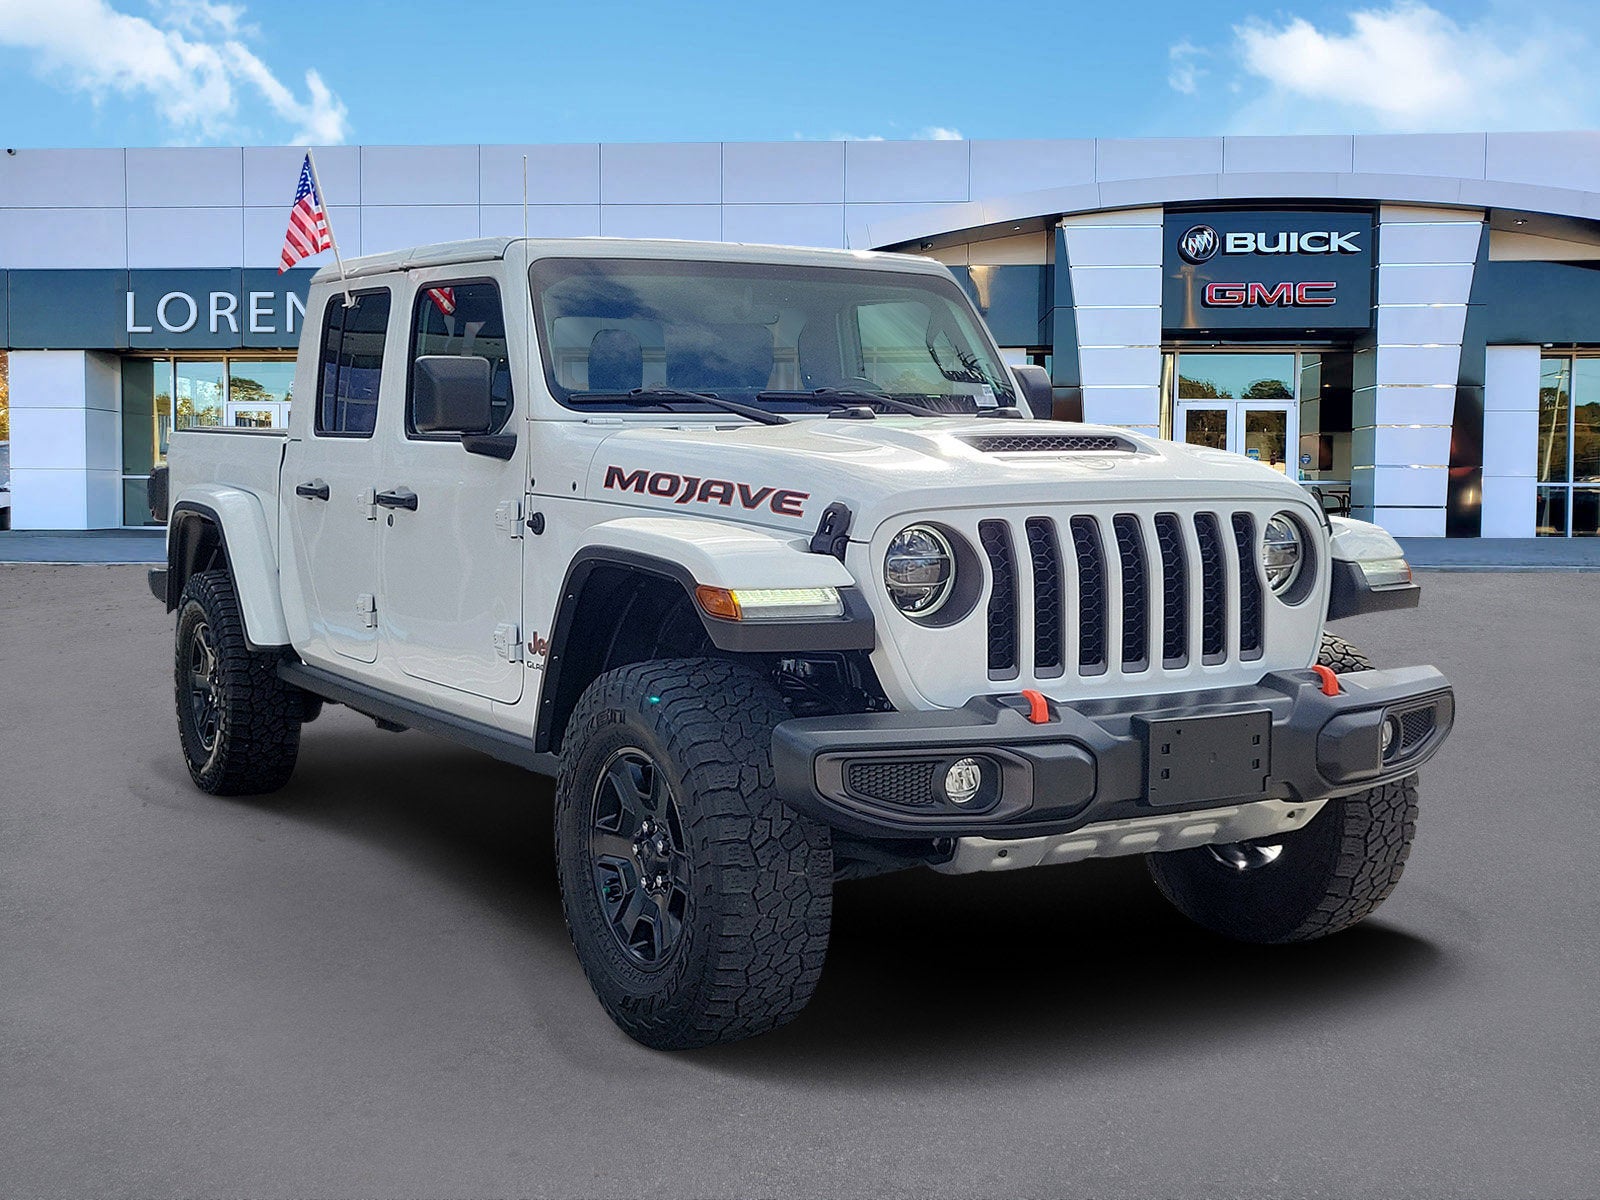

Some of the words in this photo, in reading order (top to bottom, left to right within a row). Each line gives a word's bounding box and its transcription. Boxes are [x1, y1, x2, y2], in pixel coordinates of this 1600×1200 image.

[1225, 231, 1362, 253] BUICK
[1206, 281, 1337, 305] GMC
[603, 465, 811, 518] MOJAVE
